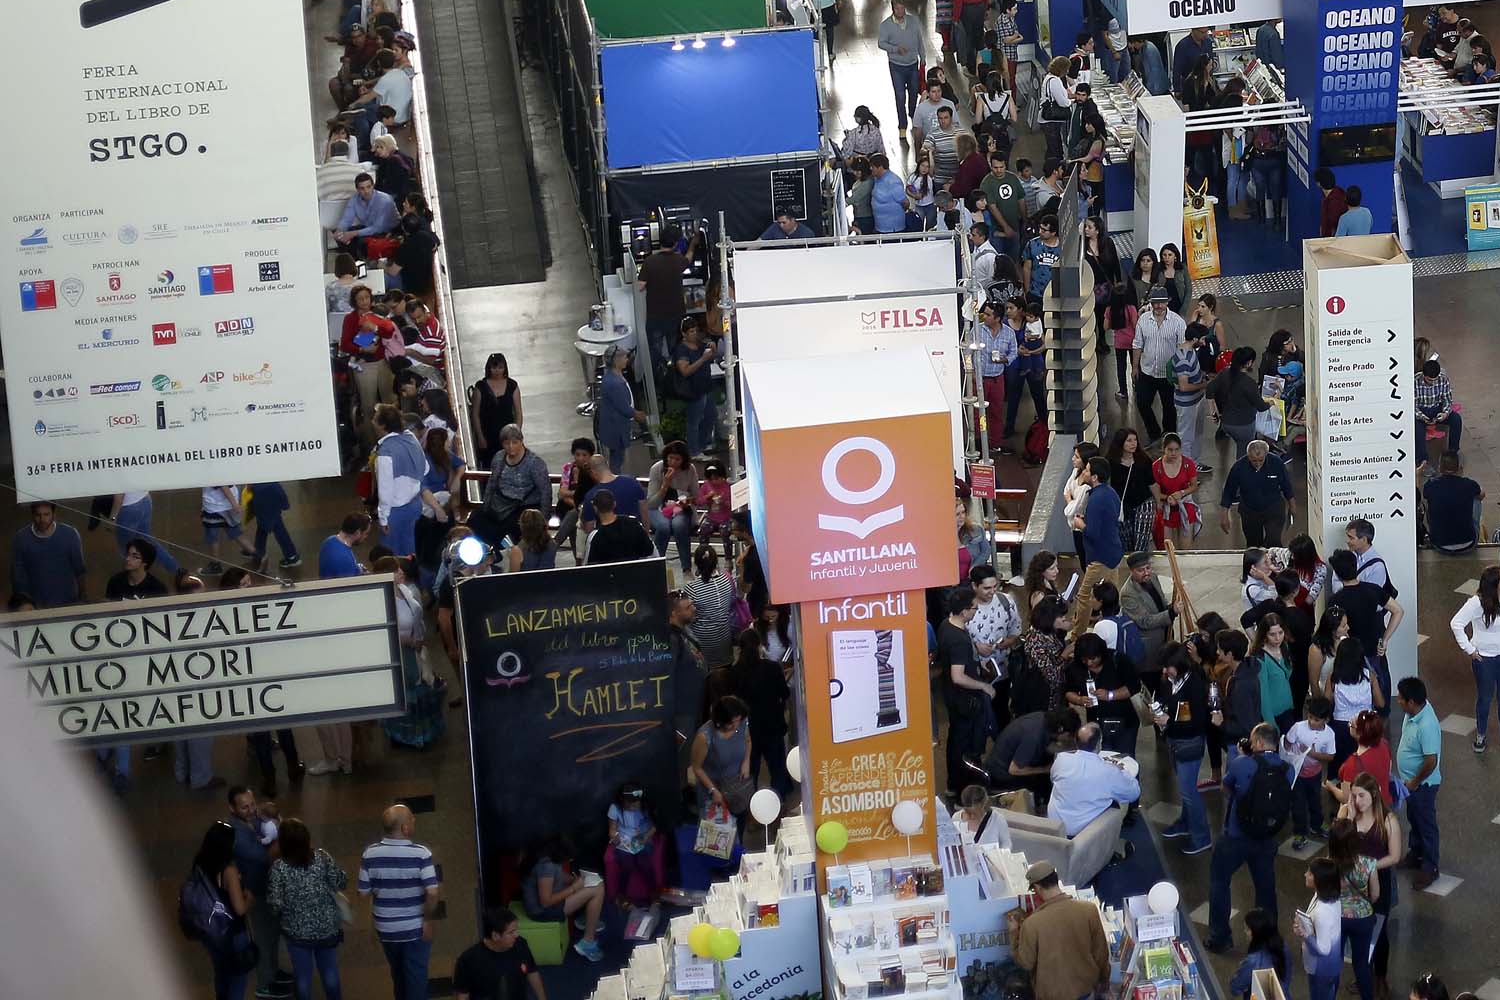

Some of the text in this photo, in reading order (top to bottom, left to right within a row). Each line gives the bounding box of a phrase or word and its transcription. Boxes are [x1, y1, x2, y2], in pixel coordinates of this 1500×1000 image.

[1326, 6, 1396, 29] OCEANO
[1324, 31, 1394, 53] OCEANO
[1323, 52, 1393, 72] OCEANO
[82, 64, 139, 79] FERIA
[1322, 72, 1391, 92] OCEANO
[84, 80, 228, 101] INTERNACIONAL
[1321, 92, 1389, 112] OCEANO
[87, 103, 210, 124] DEL LIBRO DE
[89, 131, 207, 162] STGO.
[13, 208, 105, 223] ORGANIZA PARTICIPAN
[152, 223, 169, 231] SRE
[62, 231, 108, 241] CULTURA
[244, 248, 279, 258] PRODUCE
[19, 267, 43, 276] APOYA
[148, 284, 186, 295] SANTIAGO
[96, 293, 137, 303] SANTIAGO
[74, 314, 137, 326] MEDIA PARTNERS
[216, 317, 253, 333] ADN
[880, 308, 943, 329] FILSA
[1328, 328, 1362, 337] Salida de
[93, 338, 140, 349] MERCURIO
[1328, 336, 1371, 347] Emergencia
[1352, 363, 1375, 371] Prado
[28, 373, 73, 384] COLABORAN
[233, 373, 254, 382] bike
[1328, 380, 1362, 389] Ascensor
[1329, 394, 1354, 404] Rampa
[1330, 434, 1352, 443] Baños
[50, 460, 83, 473] FERIA
[87, 452, 181, 471] INTERNACIONAL
[185, 450, 205, 461] DEL
[209, 446, 243, 459] LIBRO
[247, 445, 261, 454] DE
[265, 439, 323, 453] SANTIAGO
[1363, 455, 1393, 464] Antúnez
[1330, 473, 1379, 483] Restaurantes
[1330, 495, 1375, 507] Carpa Norte
[1331, 514, 1348, 522] Foro
[1363, 511, 1383, 519] Autor
[810, 543, 916, 566] SANTILLANA
[810, 559, 918, 580] Infantil y Juvenil
[819, 593, 908, 624] Infantil
[486, 599, 637, 637] LANZAMIENTO
[70, 601, 297, 651] GONZALEZ
[147, 646, 254, 686] MORI
[545, 667, 670, 719] HAMLET
[58, 684, 284, 735] GARAFULIC
[852, 753, 886, 772] CREA
[733, 969, 761, 989] a la
